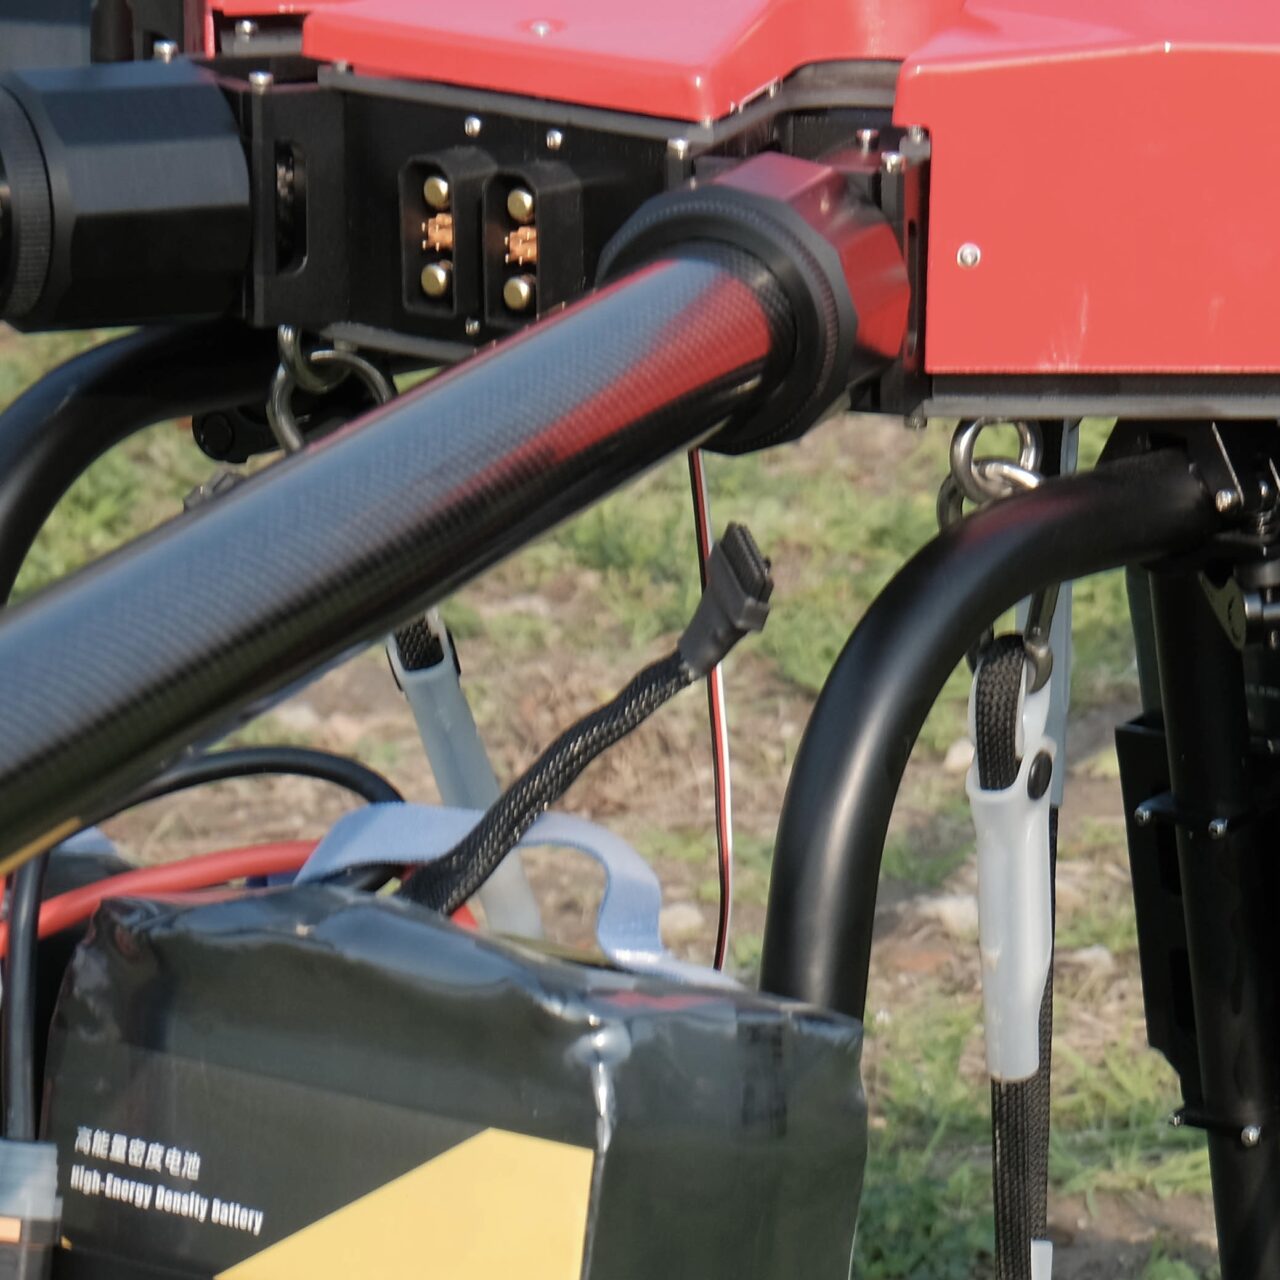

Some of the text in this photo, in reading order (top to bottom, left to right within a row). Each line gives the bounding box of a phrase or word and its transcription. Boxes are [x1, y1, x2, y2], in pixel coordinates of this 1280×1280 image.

[74, 1126, 201, 1181] 高能量密度电池
[70, 1164, 265, 1237] High-Energy Density Battery
